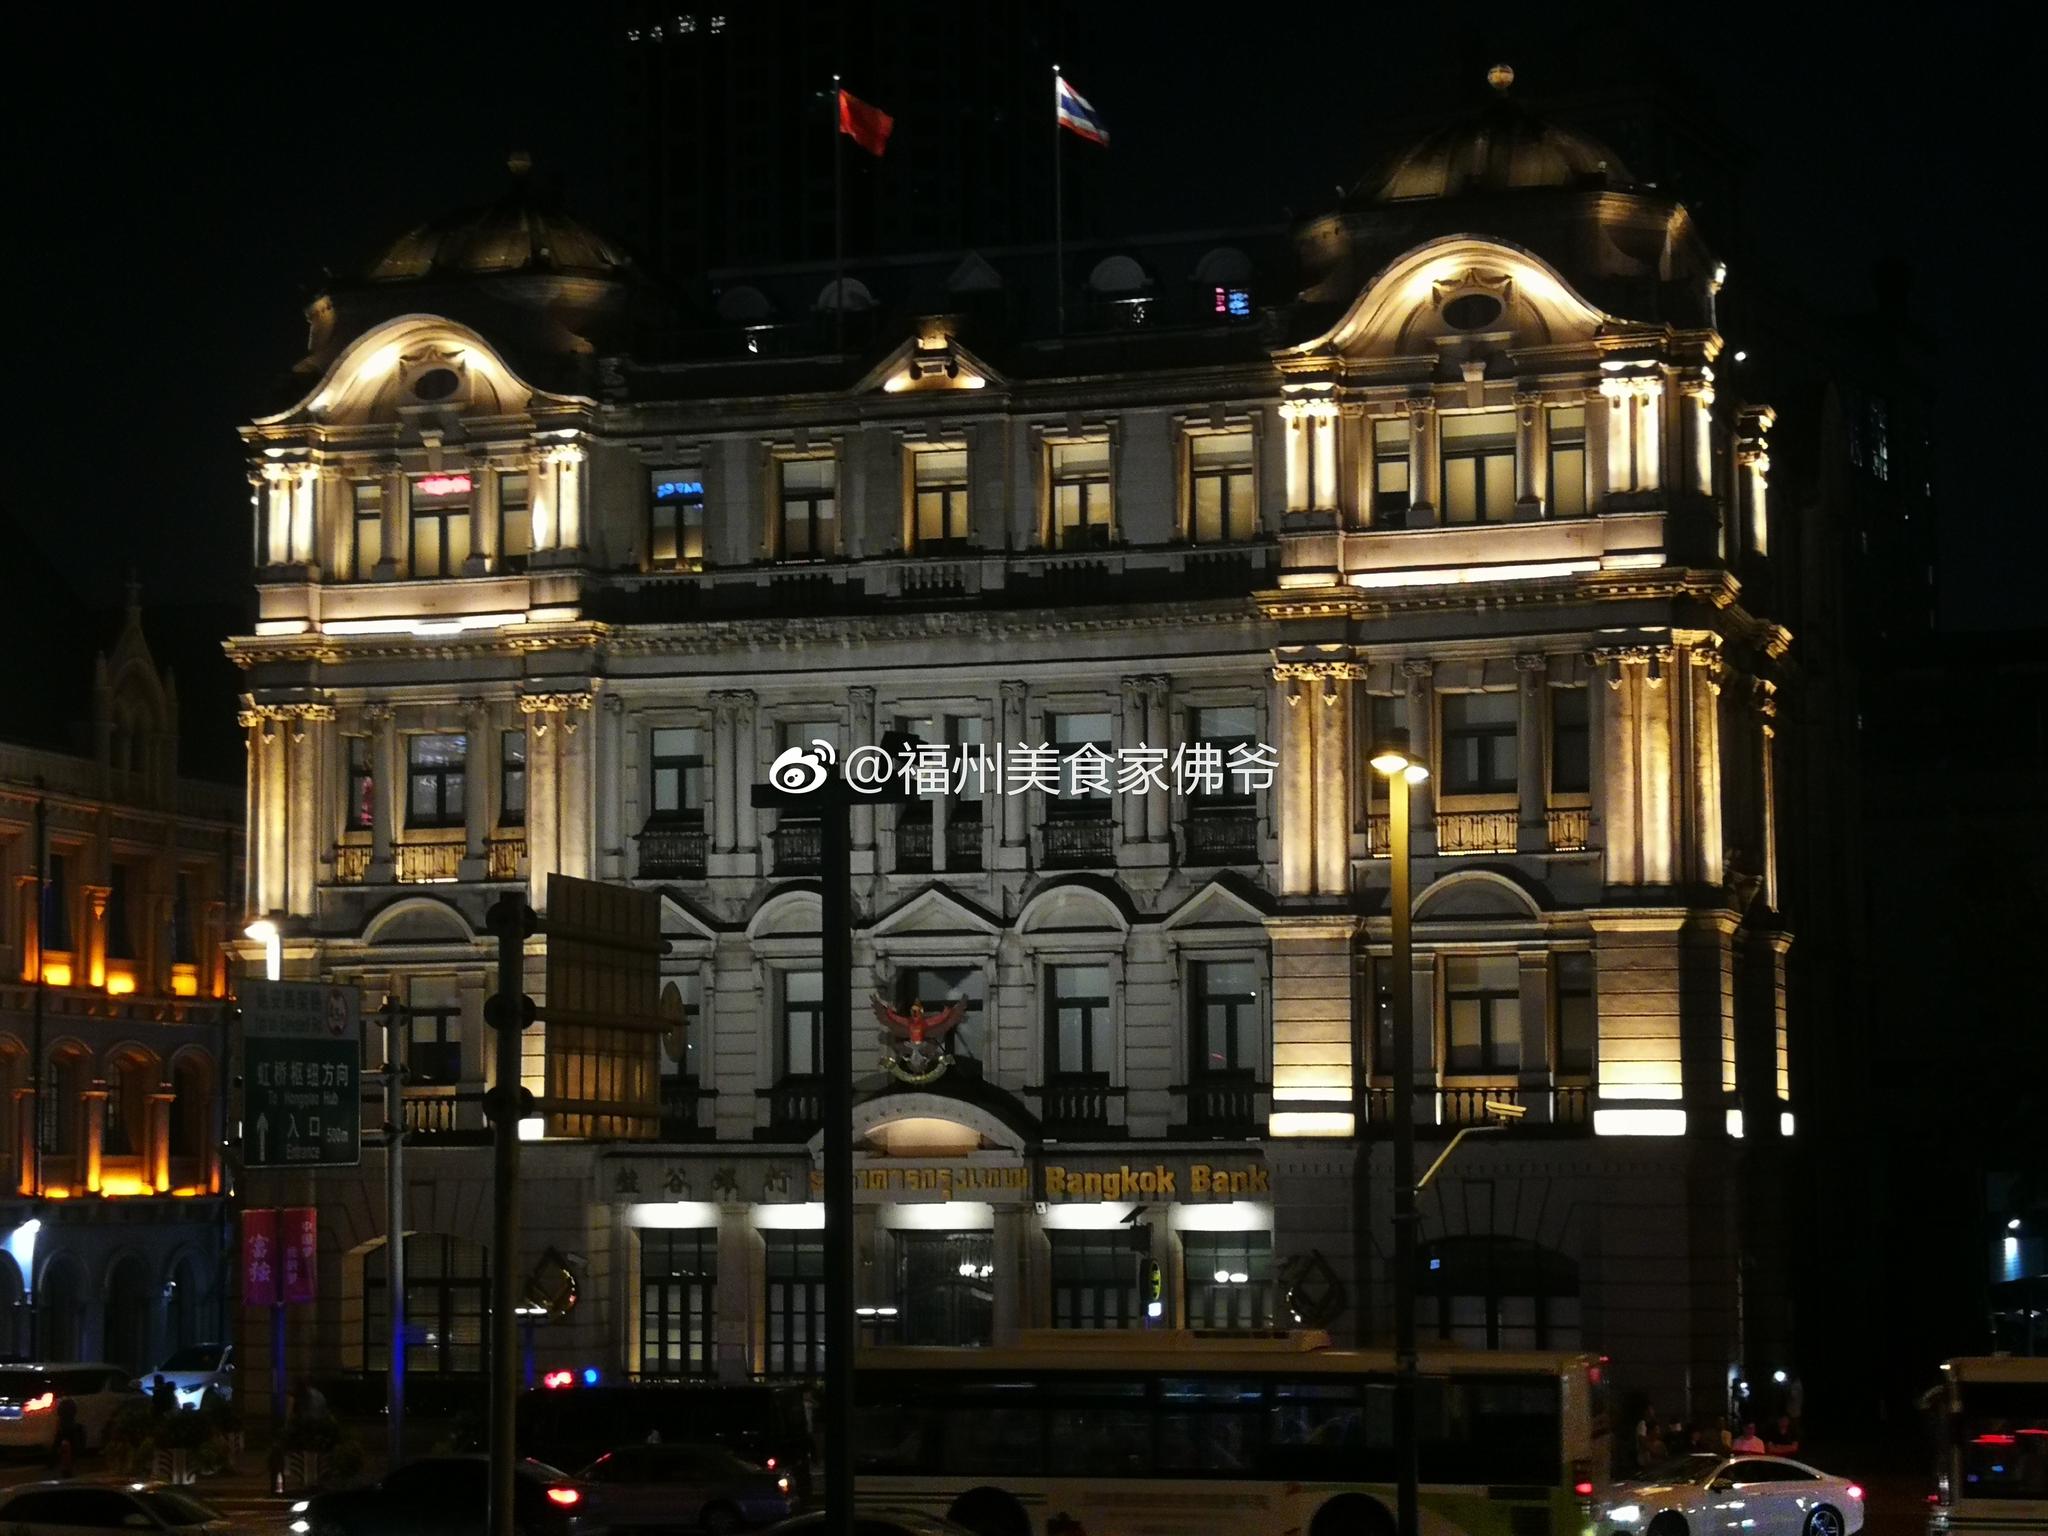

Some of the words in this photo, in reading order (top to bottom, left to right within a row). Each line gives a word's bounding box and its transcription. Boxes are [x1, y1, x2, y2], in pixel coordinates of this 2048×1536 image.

[257, 1061, 349, 1087] 虹桥枢纽方向
[287, 1112, 321, 1139] 入口
[1045, 1165, 1176, 1200] Bangkok
[1190, 1164, 1269, 1193] Bank
